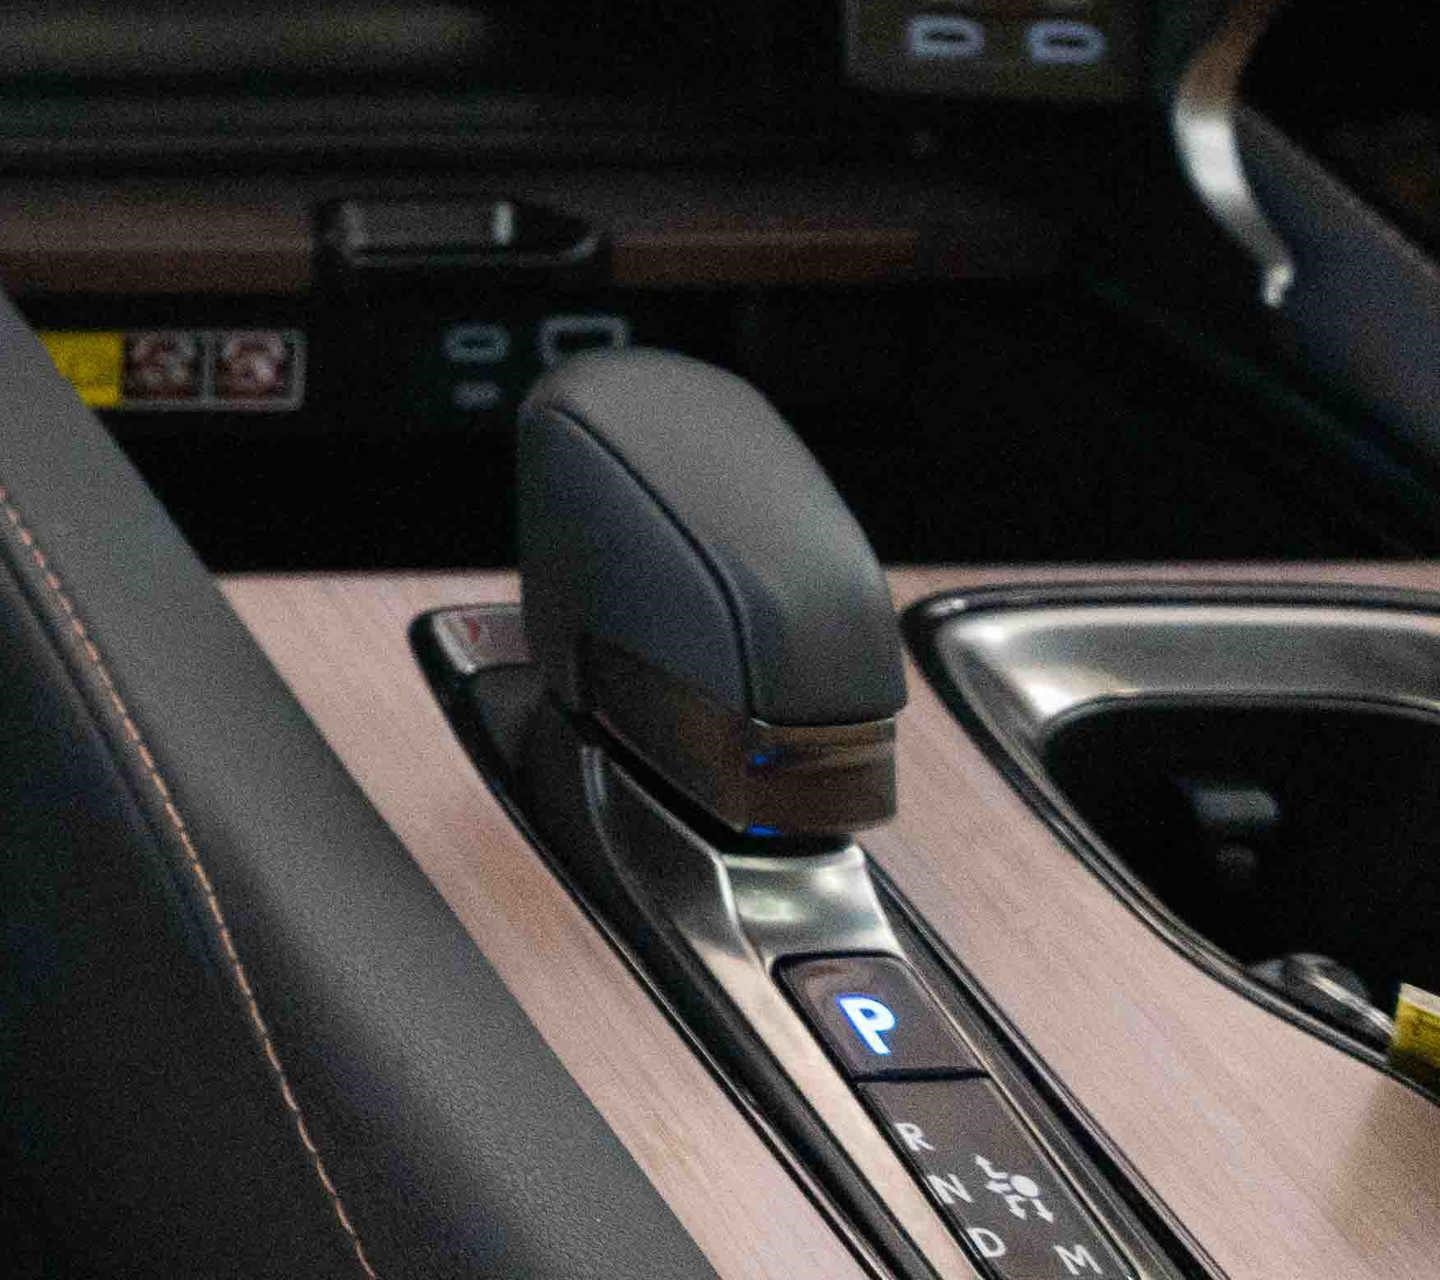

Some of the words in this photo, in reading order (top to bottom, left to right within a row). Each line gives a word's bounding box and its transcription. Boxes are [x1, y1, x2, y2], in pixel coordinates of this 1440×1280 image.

[835, 993, 898, 1056] P
[894, 1121, 936, 1152] R
[927, 1173, 973, 1205] N
[966, 1226, 1007, 1259] D
[1053, 1243, 1104, 1276] M
